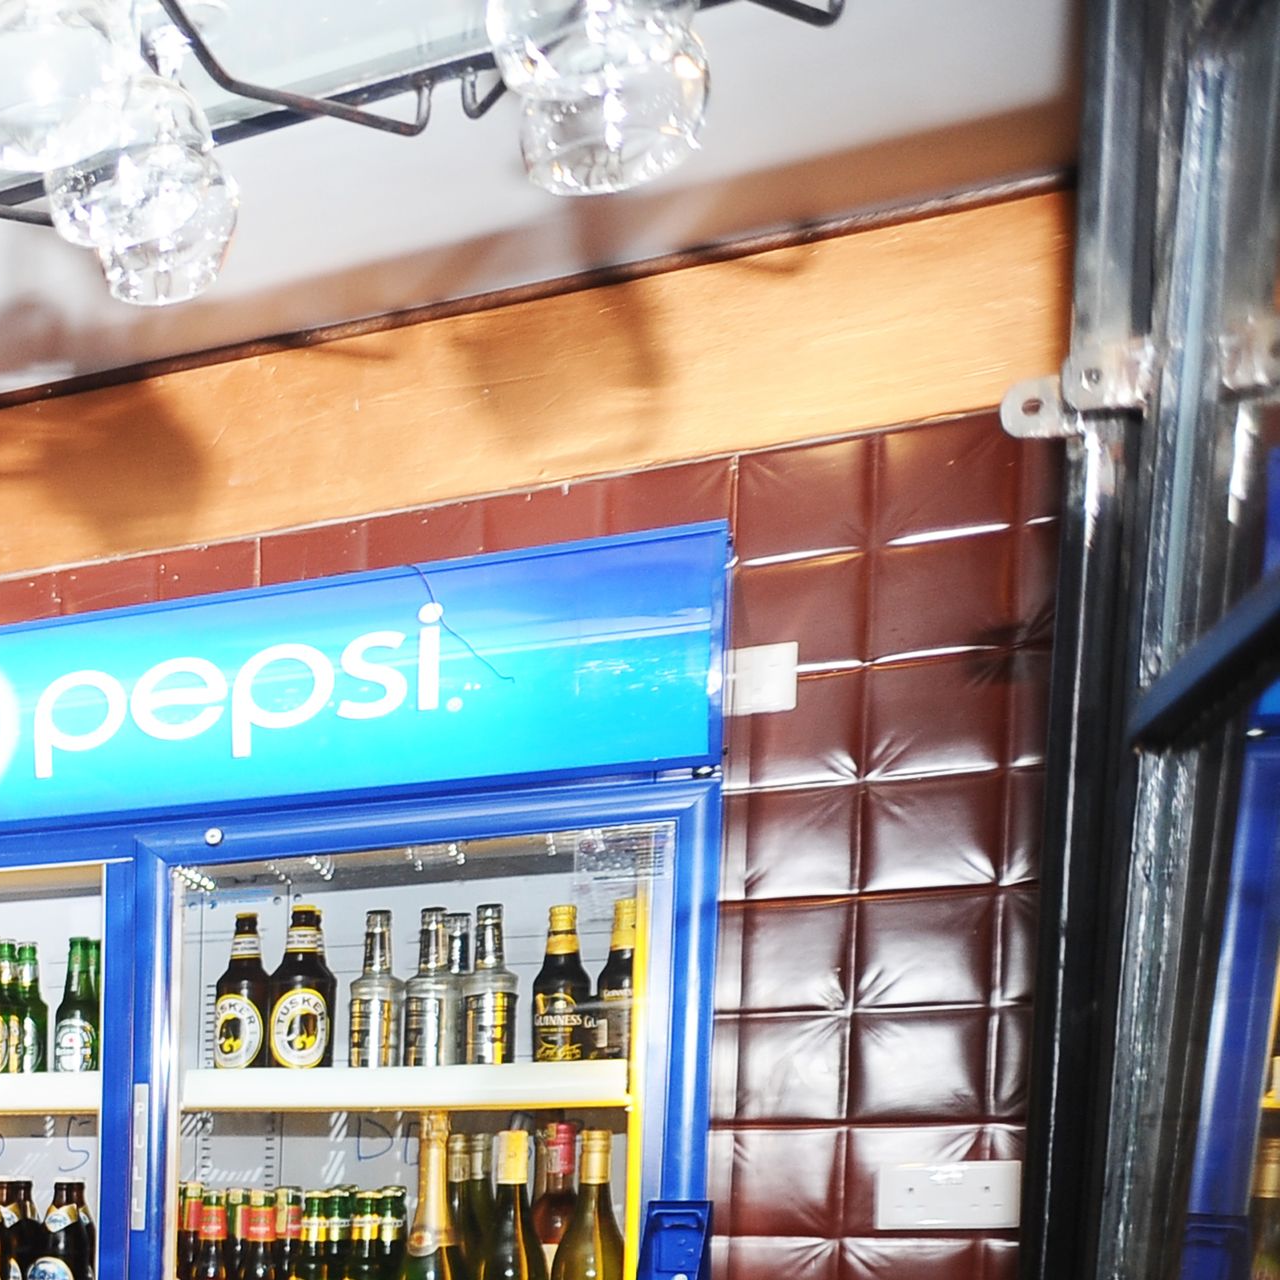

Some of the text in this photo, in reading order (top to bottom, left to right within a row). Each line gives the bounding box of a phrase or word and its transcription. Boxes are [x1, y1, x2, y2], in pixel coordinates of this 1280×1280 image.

[34, 602, 444, 779] pepsi
[276, 996, 326, 1024] TUSKER
[534, 1013, 582, 1027] GUINNESS
[132, 1101, 146, 1213] PULL
